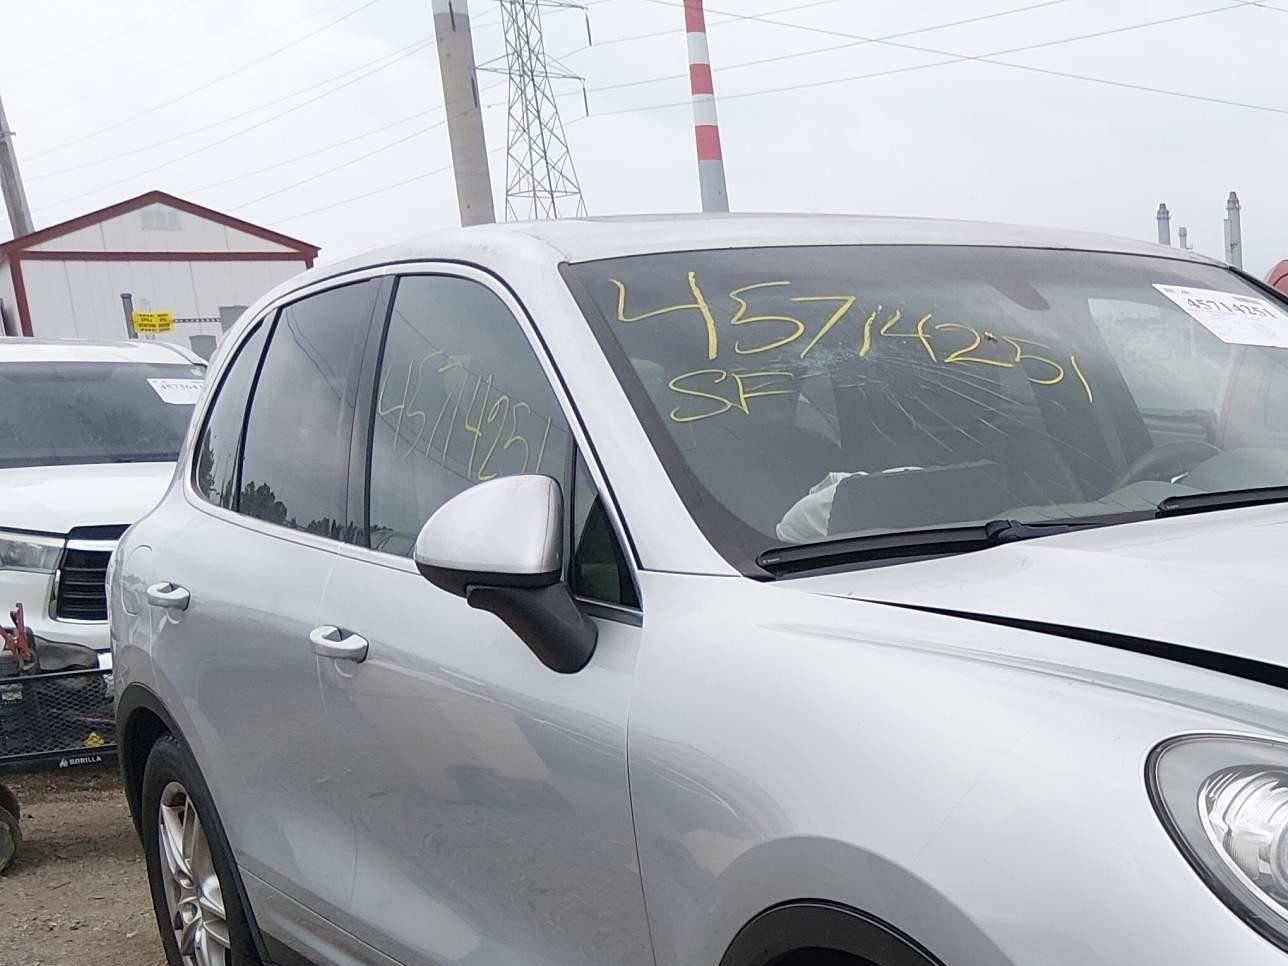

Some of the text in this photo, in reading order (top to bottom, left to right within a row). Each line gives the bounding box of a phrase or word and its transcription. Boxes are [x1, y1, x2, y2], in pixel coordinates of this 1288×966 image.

[609, 271, 1094, 403] 45714251
[1187, 298, 1278, 319] 45714251
[378, 350, 552, 481] 45714251
[669, 369, 796, 422] SF
